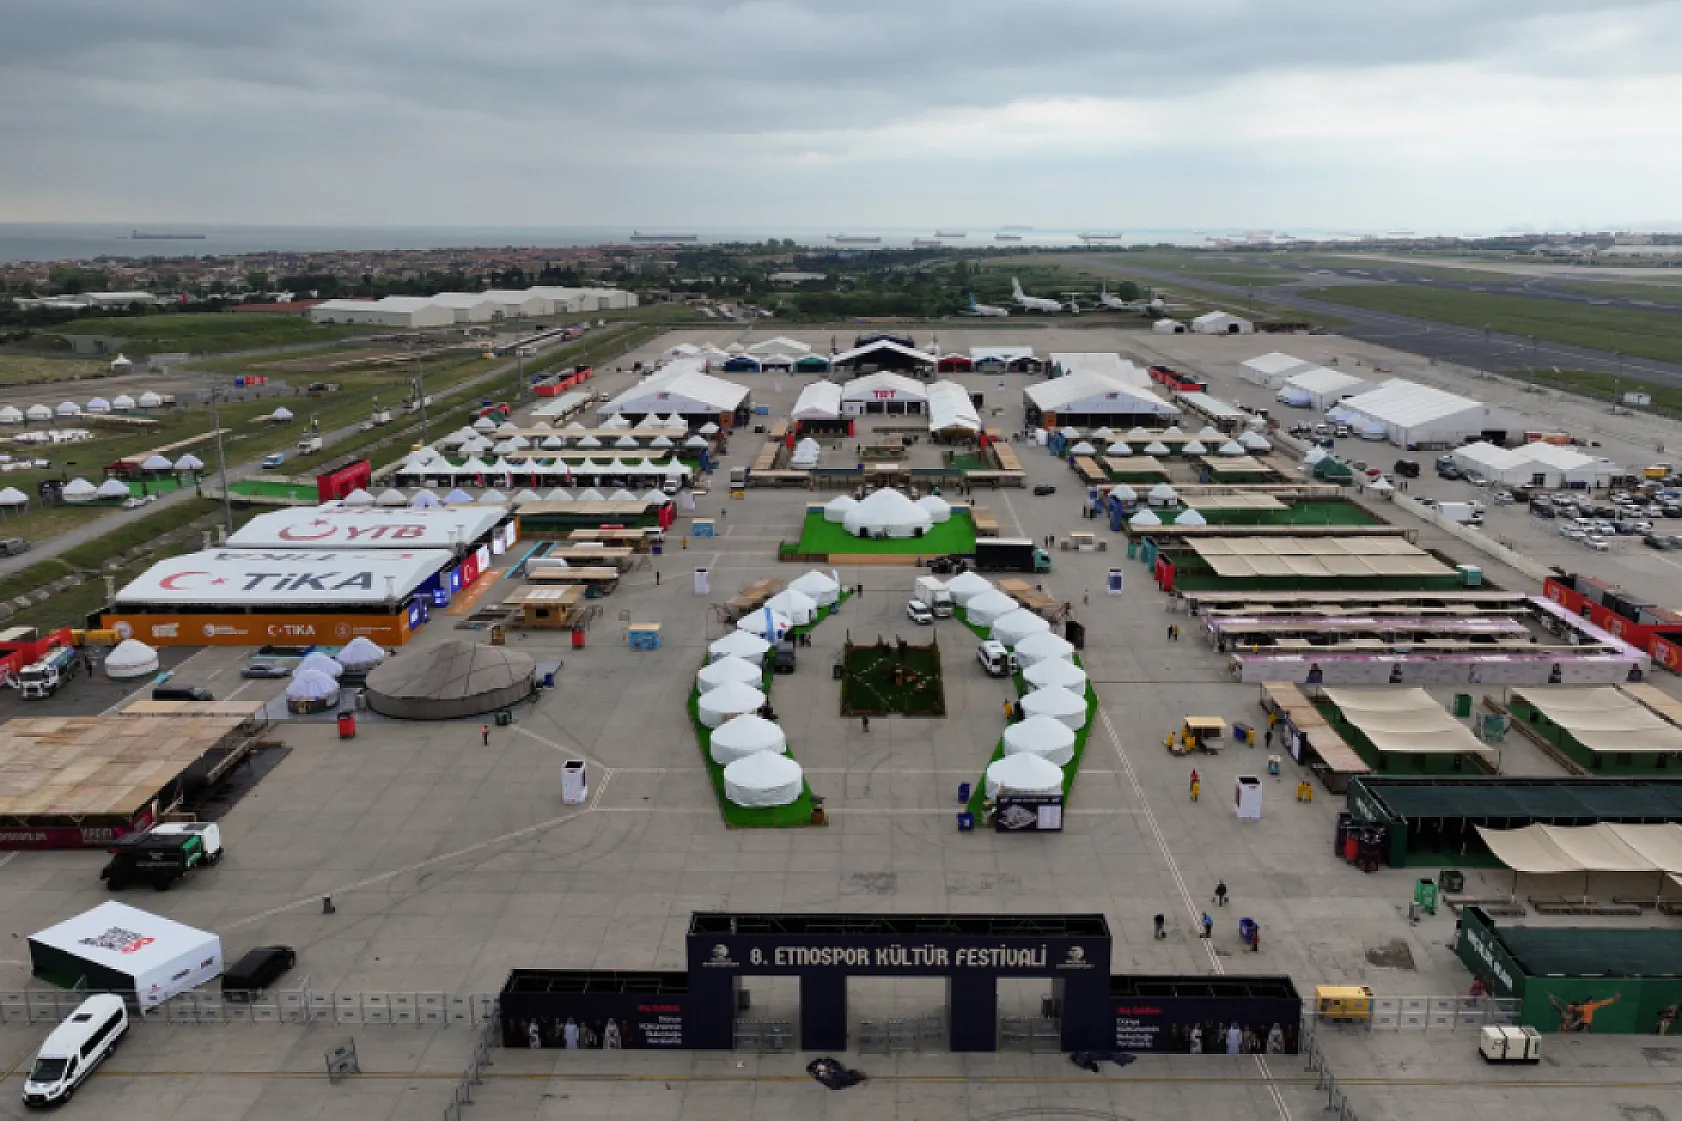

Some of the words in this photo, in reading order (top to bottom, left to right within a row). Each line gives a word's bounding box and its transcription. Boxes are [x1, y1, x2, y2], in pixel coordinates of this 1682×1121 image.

[346, 524, 428, 541] YTB
[750, 947, 768, 966] 8.
[775, 946, 870, 966] ETNOSPOR
[876, 944, 948, 966] KÜLTÜR
[956, 944, 1047, 966] FESTİVALİ
